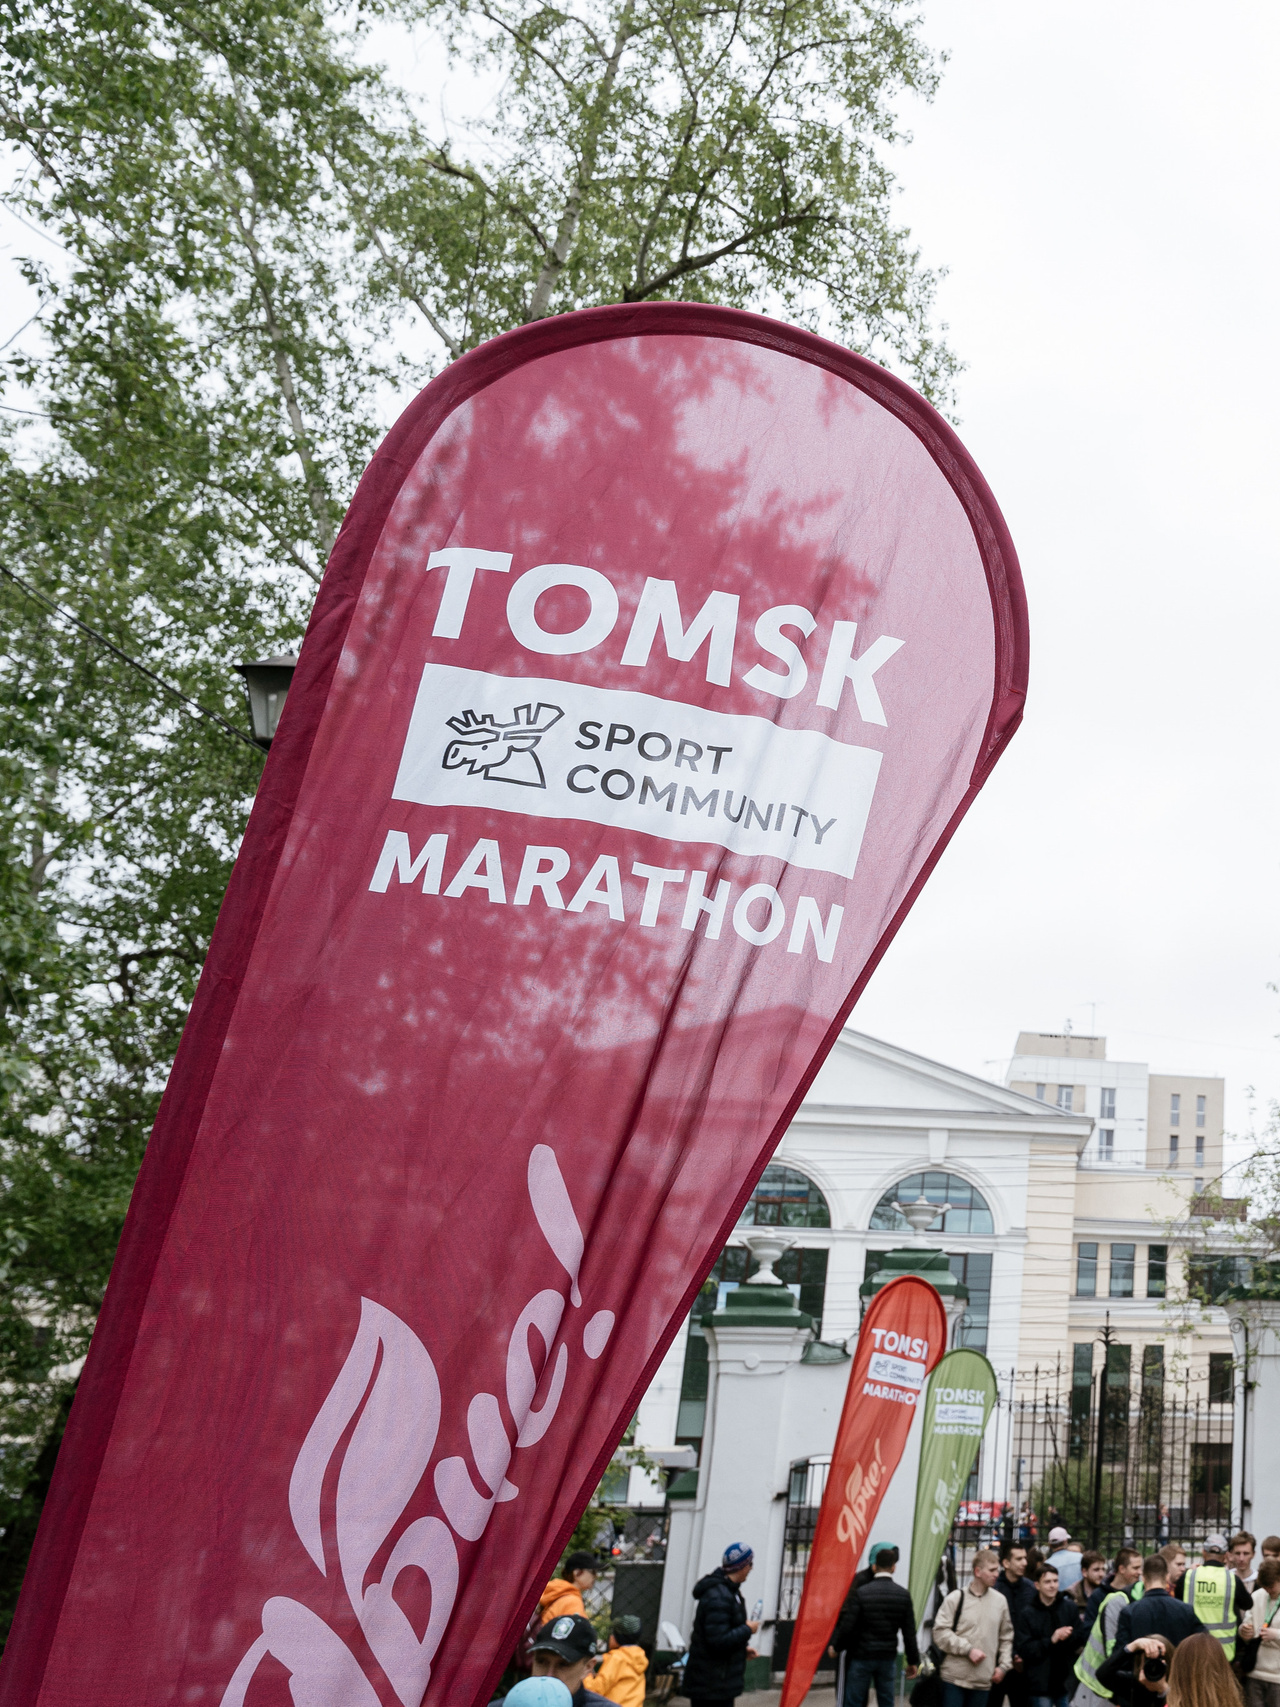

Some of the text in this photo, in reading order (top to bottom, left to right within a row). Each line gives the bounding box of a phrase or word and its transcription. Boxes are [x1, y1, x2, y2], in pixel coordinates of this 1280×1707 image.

[426, 547, 905, 727] TOMSK
[574, 721, 733, 775] SPORT
[566, 764, 837, 845] COMMUNITY
[368, 829, 845, 963] MARATHON
[934, 1387, 986, 1405] TOMSK
